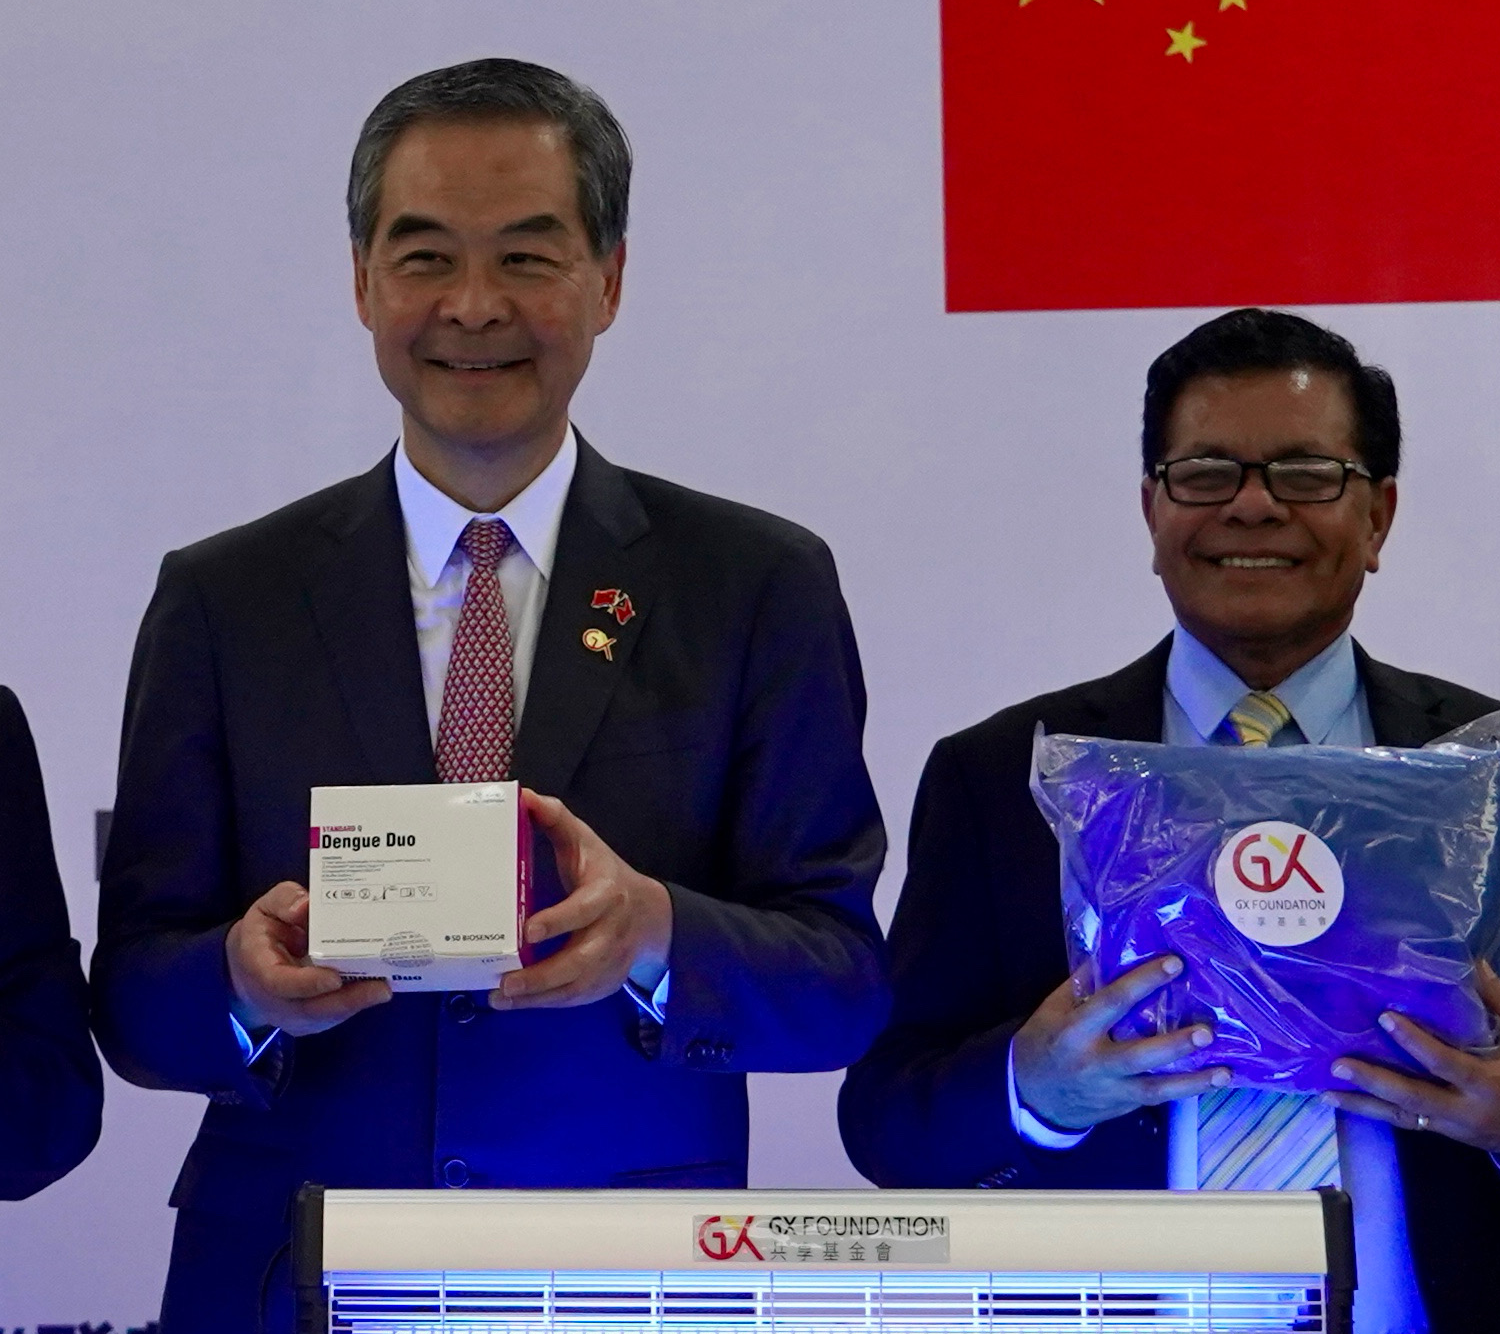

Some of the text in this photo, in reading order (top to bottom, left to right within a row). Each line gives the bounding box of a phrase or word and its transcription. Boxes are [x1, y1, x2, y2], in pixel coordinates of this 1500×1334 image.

[322, 832, 416, 851] Dengue Duo
[1233, 834, 1325, 893] GX
[1235, 899, 1326, 911] GX FOUNDATION
[462, 933, 505, 941] BIOSENSOR
[698, 1215, 945, 1261] GX GX FOUNDATION
